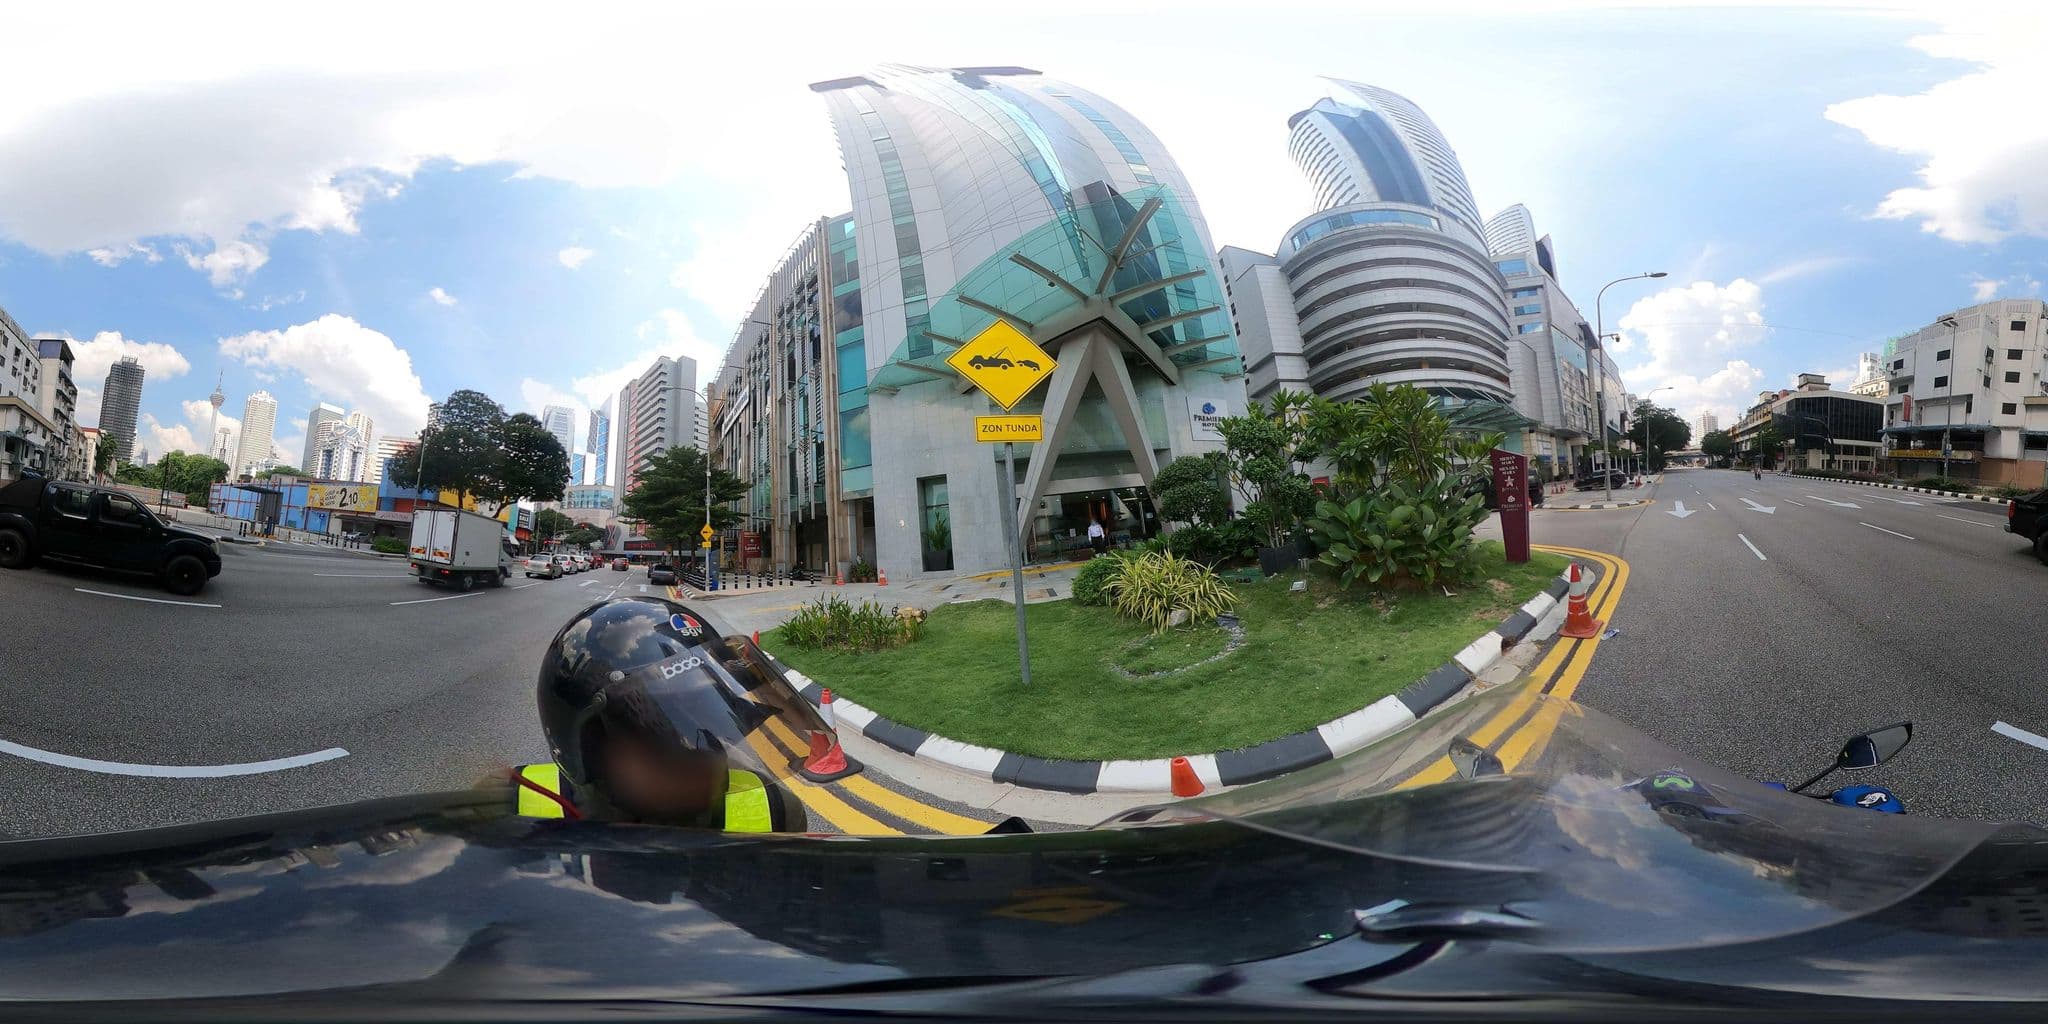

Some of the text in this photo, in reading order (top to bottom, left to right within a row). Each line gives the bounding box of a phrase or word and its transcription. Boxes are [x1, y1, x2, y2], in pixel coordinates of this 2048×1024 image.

[1193, 414, 1222, 422] PREMIER
[982, 424, 1038, 432] ZON TUNDA
[339, 488, 358, 507] 2.10
[680, 626, 703, 637] sgv
